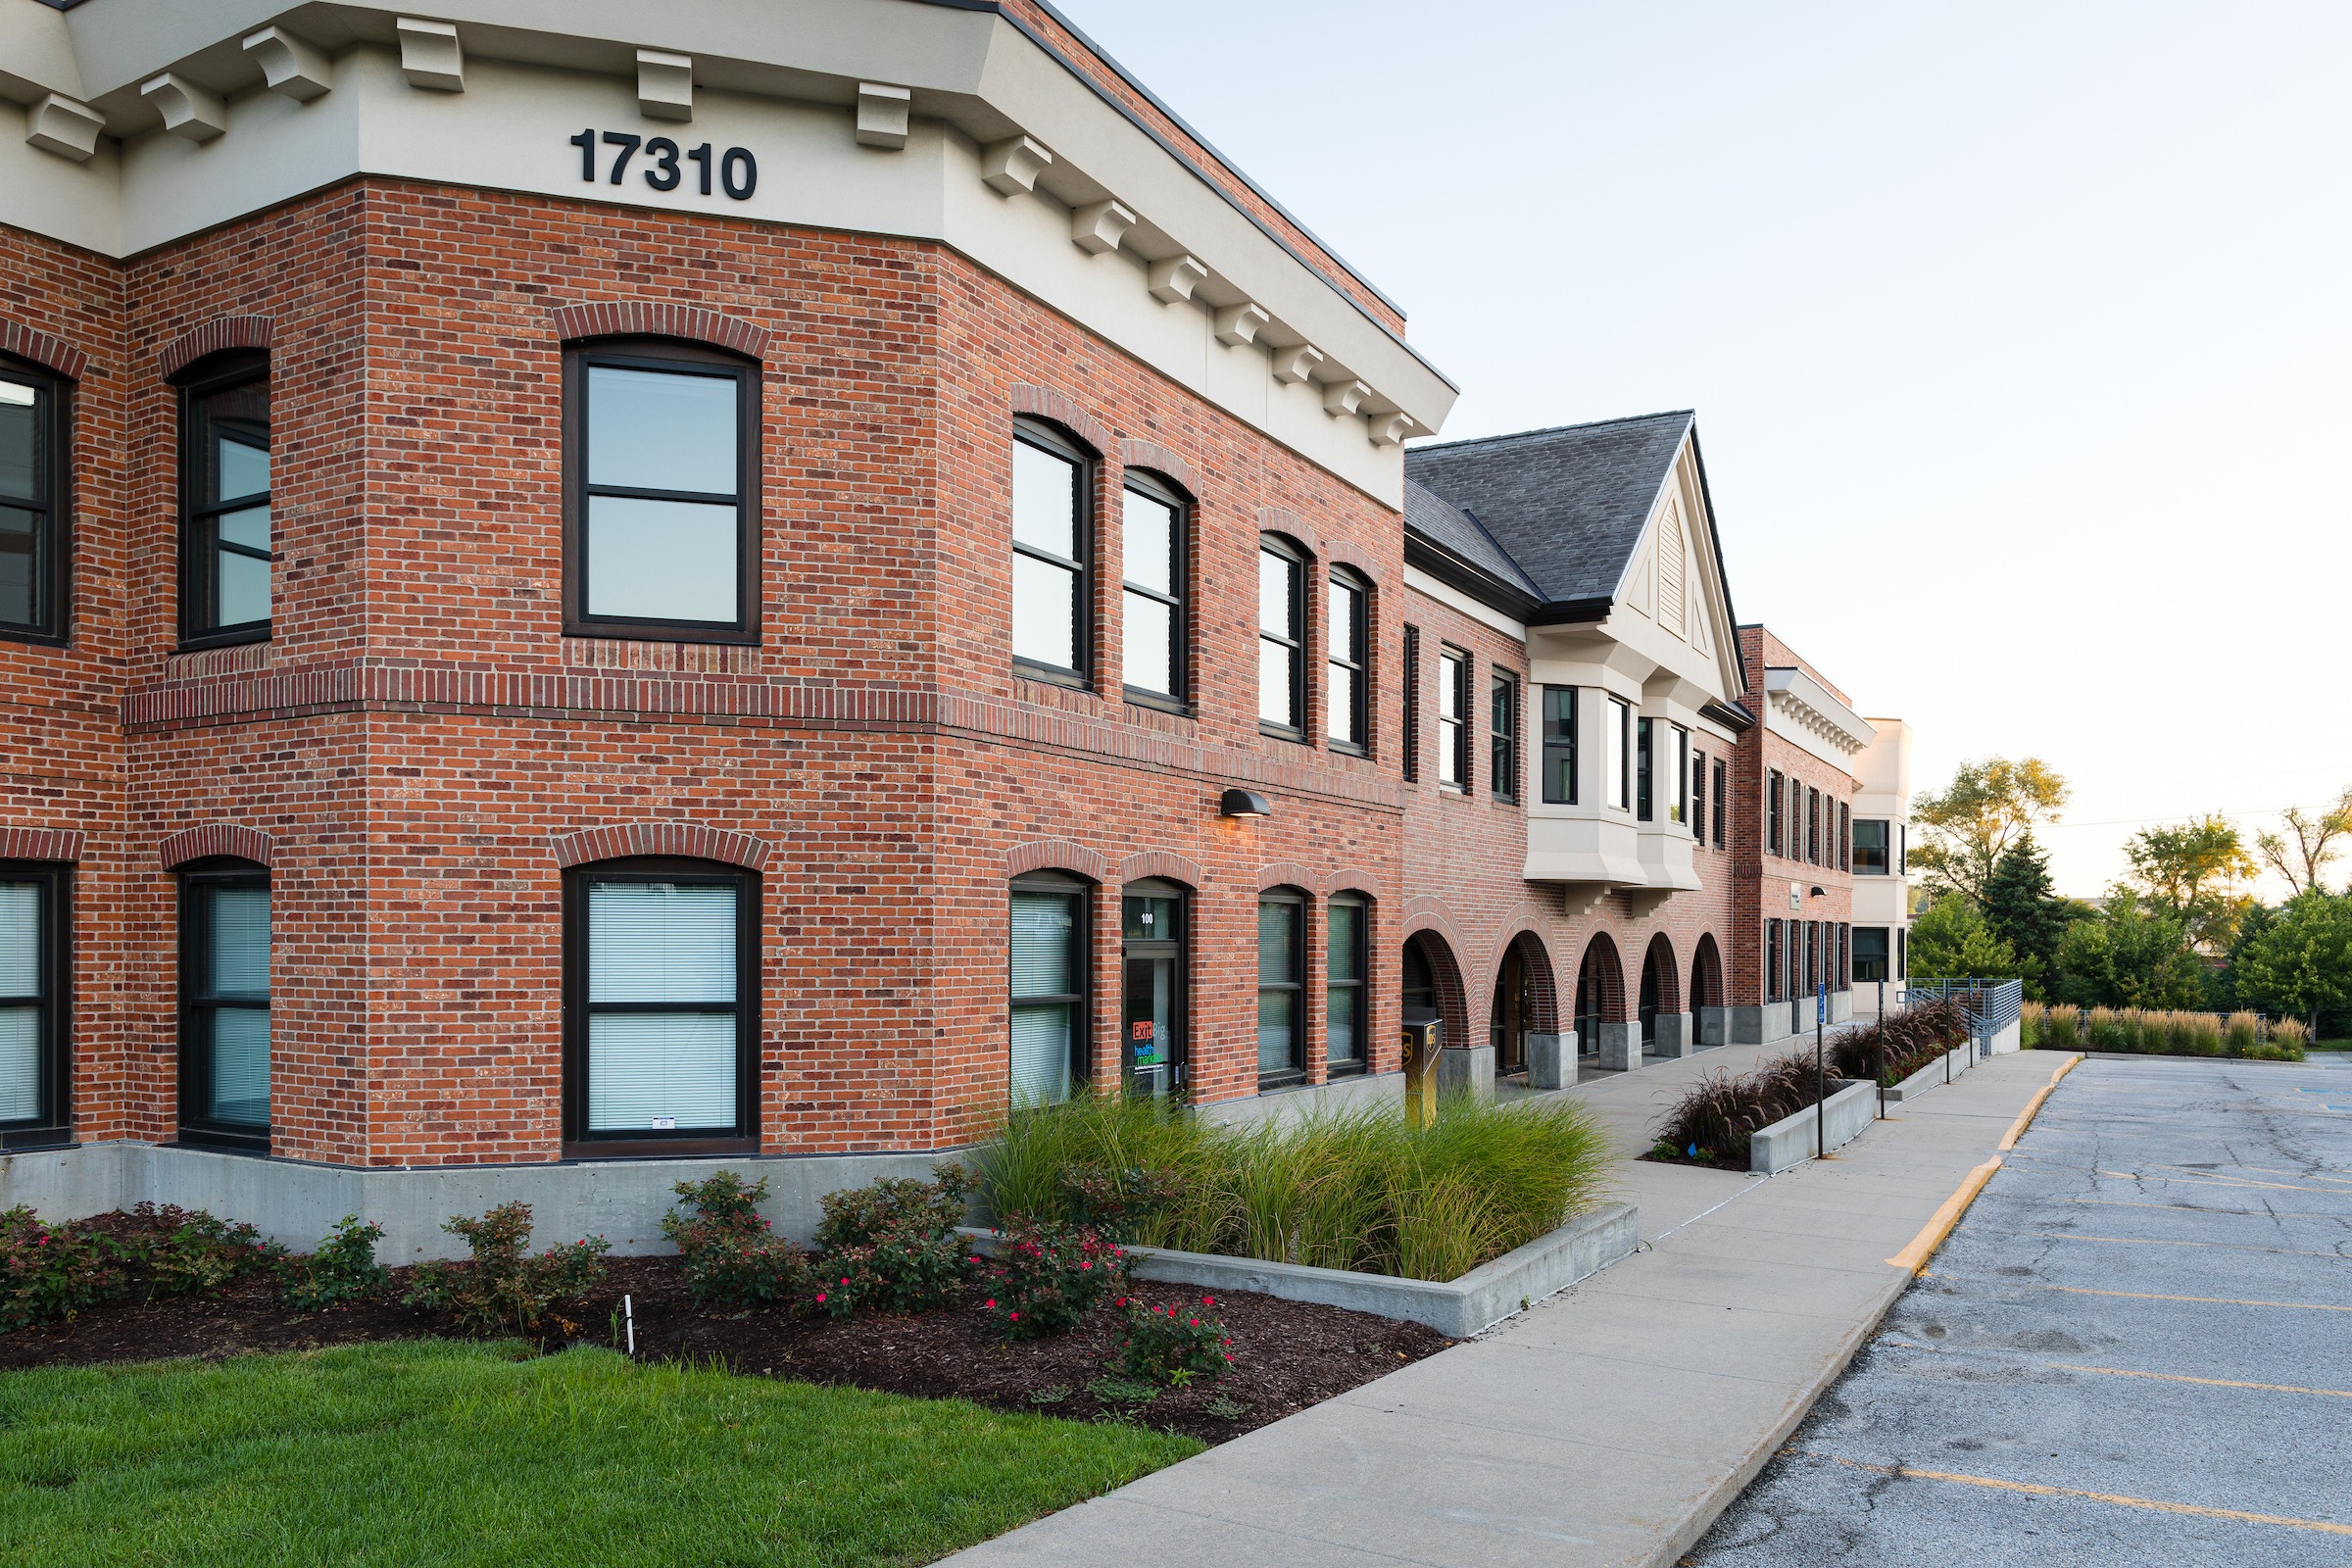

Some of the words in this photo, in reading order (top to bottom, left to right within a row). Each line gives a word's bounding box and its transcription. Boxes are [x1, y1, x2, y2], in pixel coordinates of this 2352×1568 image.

[570, 128, 758, 200] 17310
[1141, 912, 1153, 924] 100
[1134, 1044, 1154, 1057] health
[1137, 1052, 1163, 1065] markets
